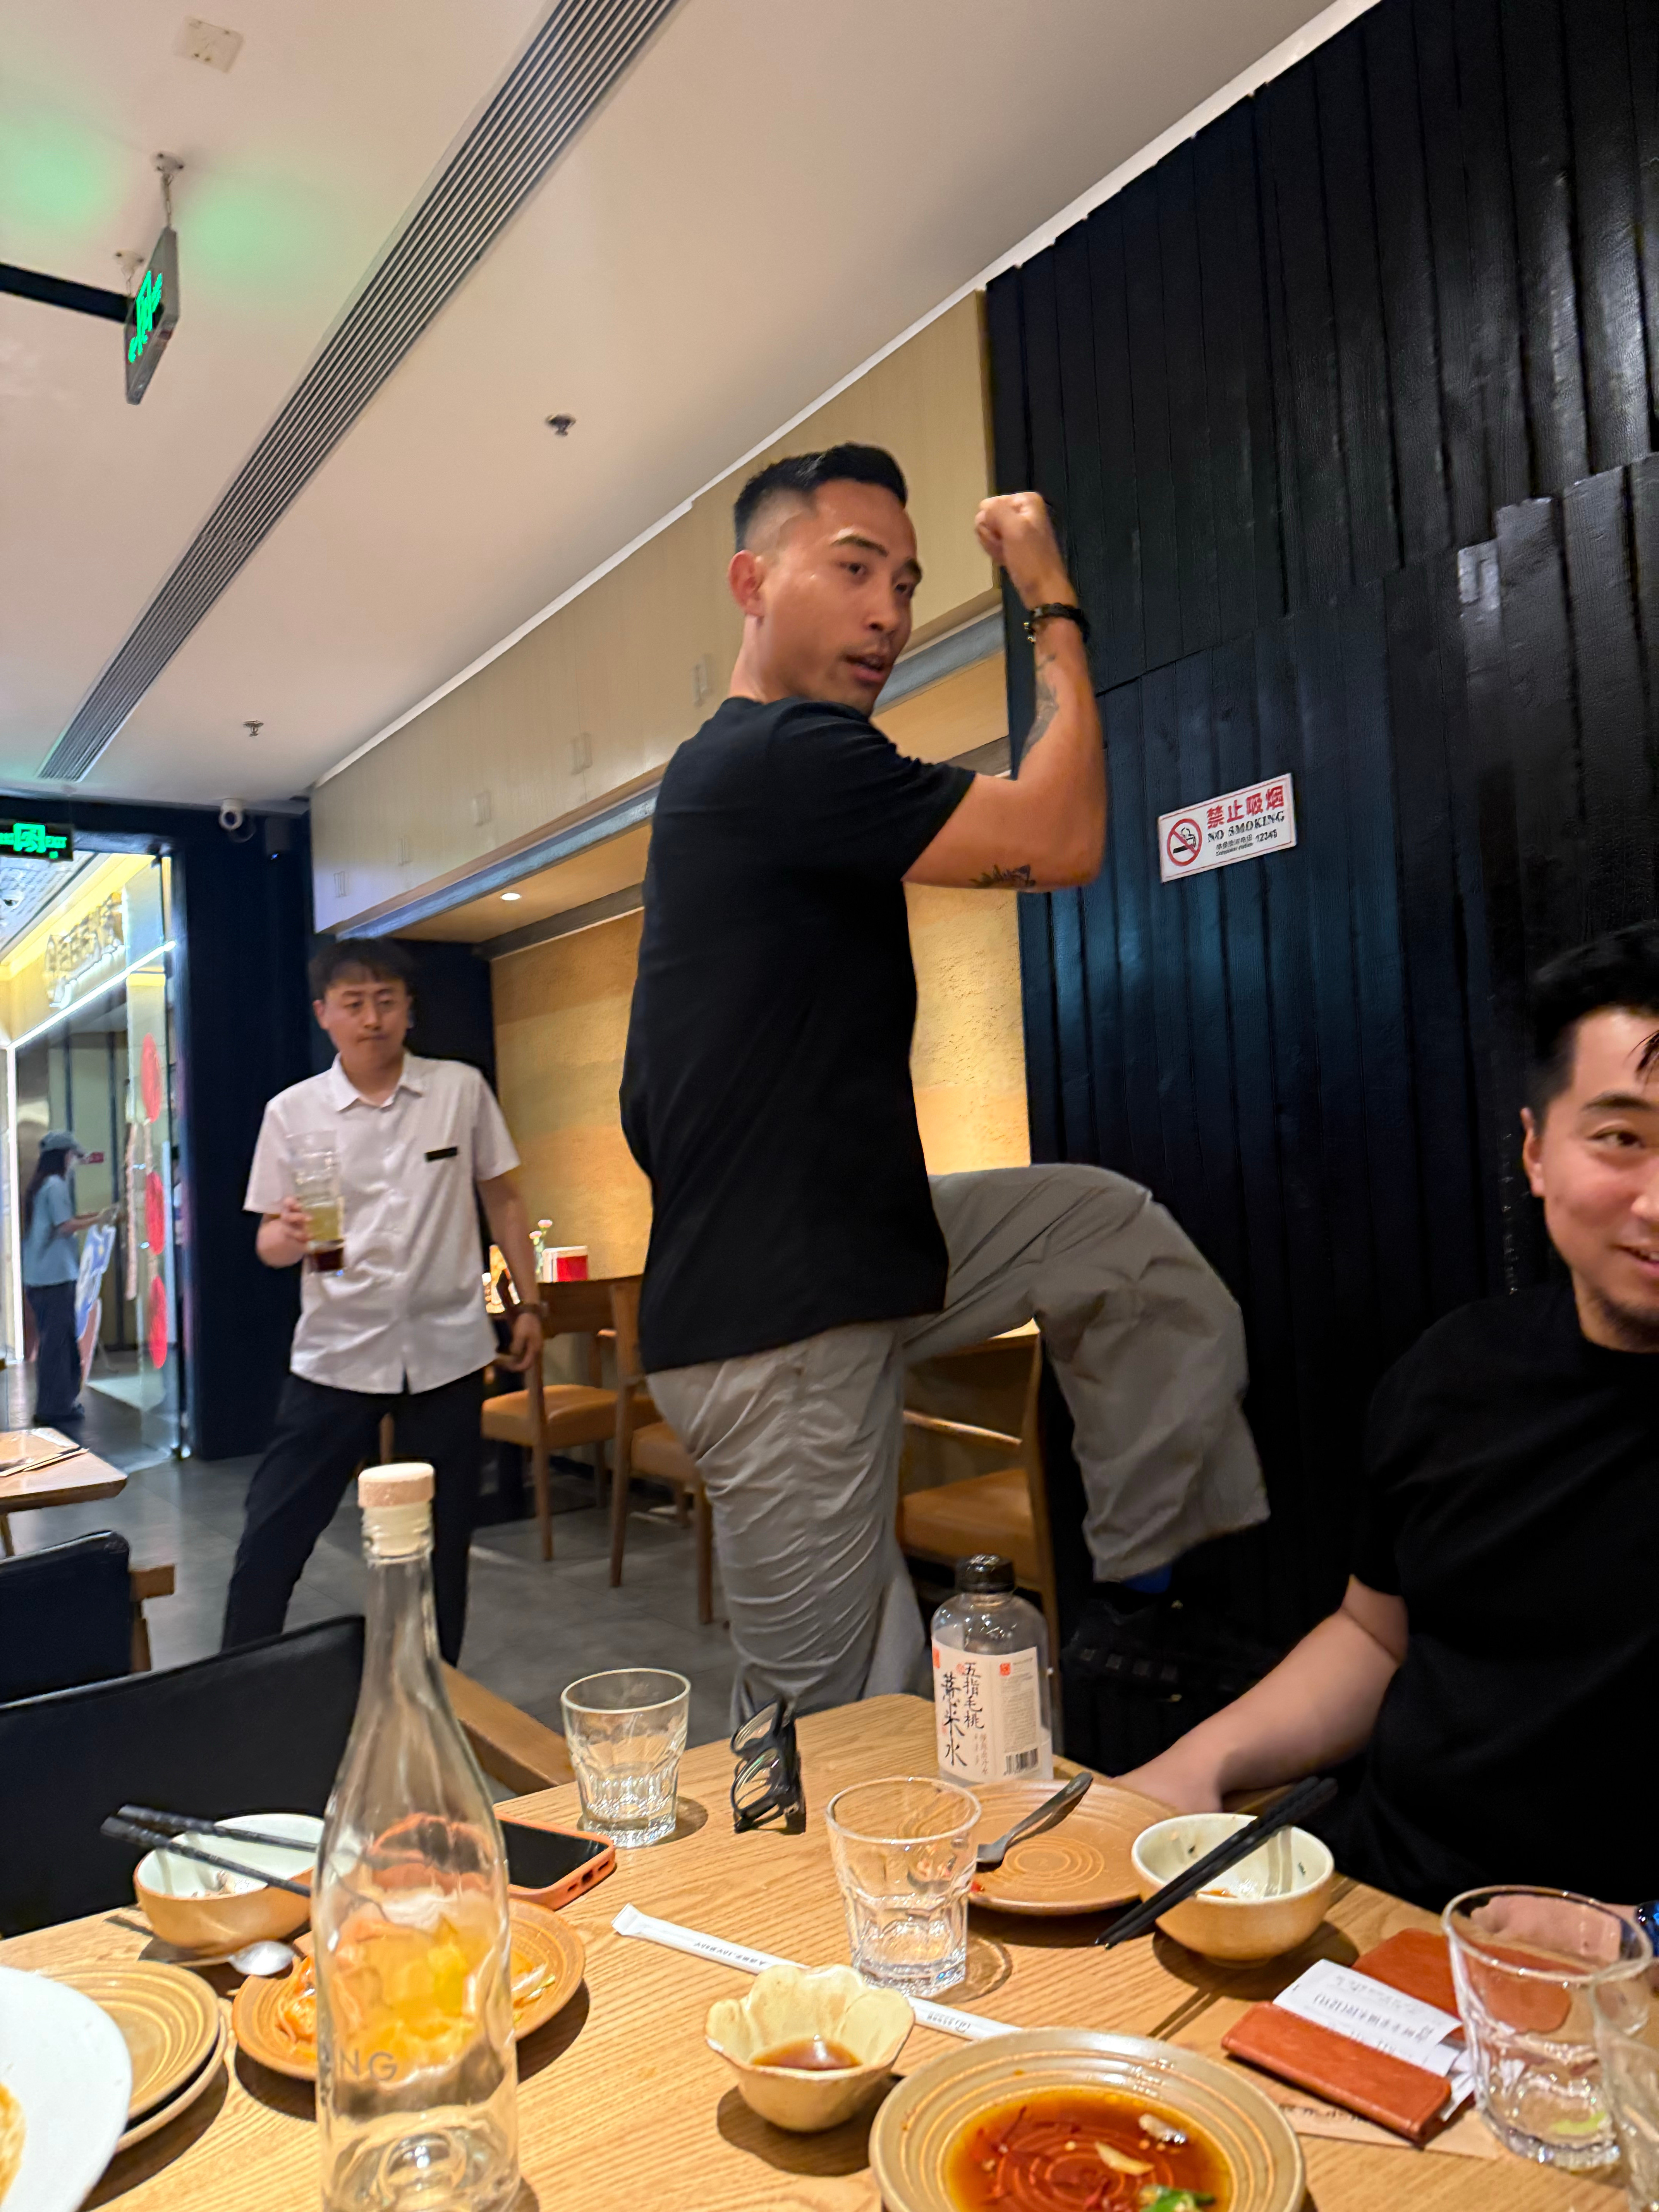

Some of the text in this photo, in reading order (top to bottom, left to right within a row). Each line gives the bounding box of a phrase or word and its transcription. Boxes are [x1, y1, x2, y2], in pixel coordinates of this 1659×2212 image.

[1206, 785, 1284, 830] 禁止吸烟
[1207, 811, 1285, 843] NO SMOKING
[962, 1662, 985, 1729] 五指毛桃
